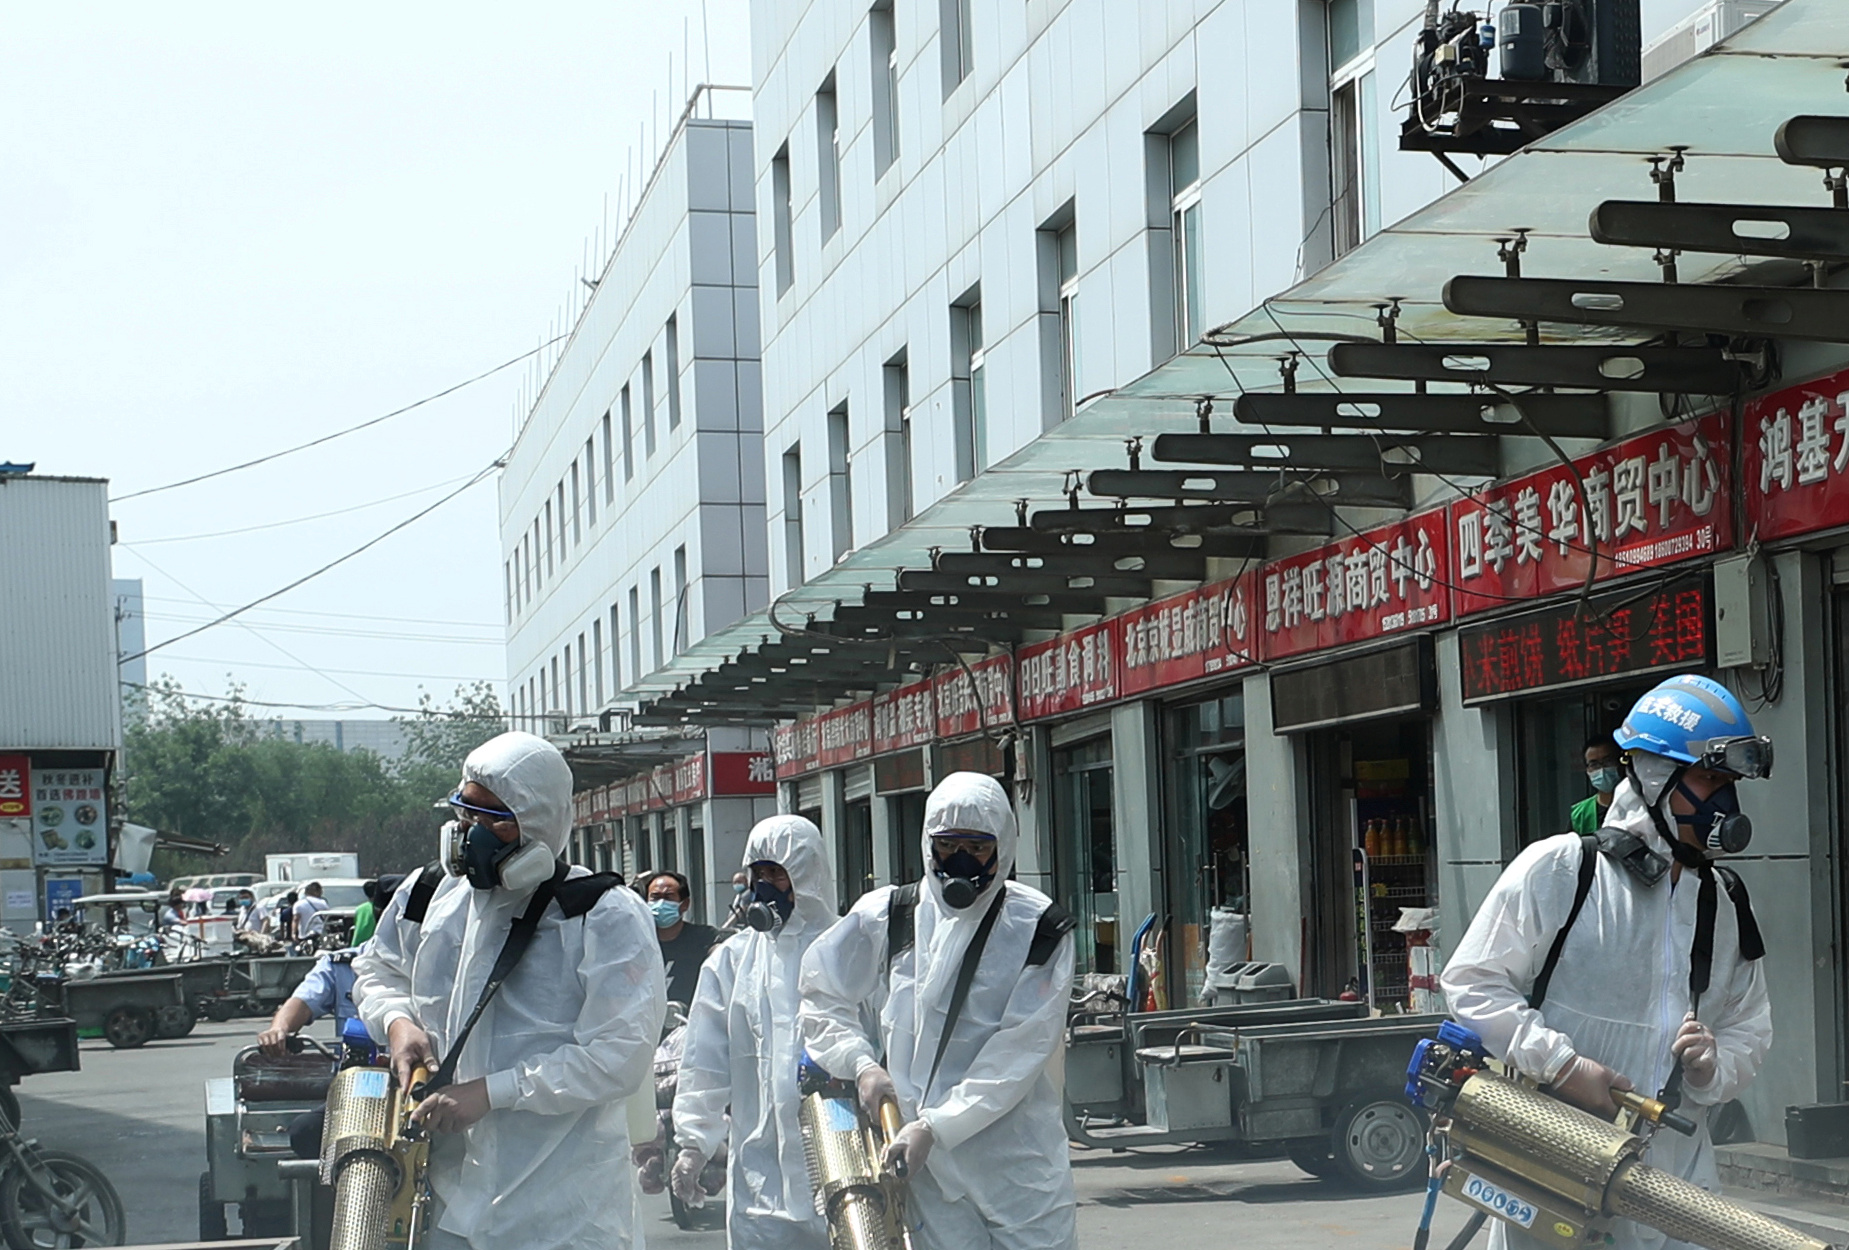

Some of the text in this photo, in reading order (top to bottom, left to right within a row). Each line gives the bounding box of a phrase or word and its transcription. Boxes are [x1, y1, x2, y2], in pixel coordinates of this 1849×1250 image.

[1458, 436, 1719, 579] 四季美华商贸中心
[1649, 590, 1703, 665] 美国
